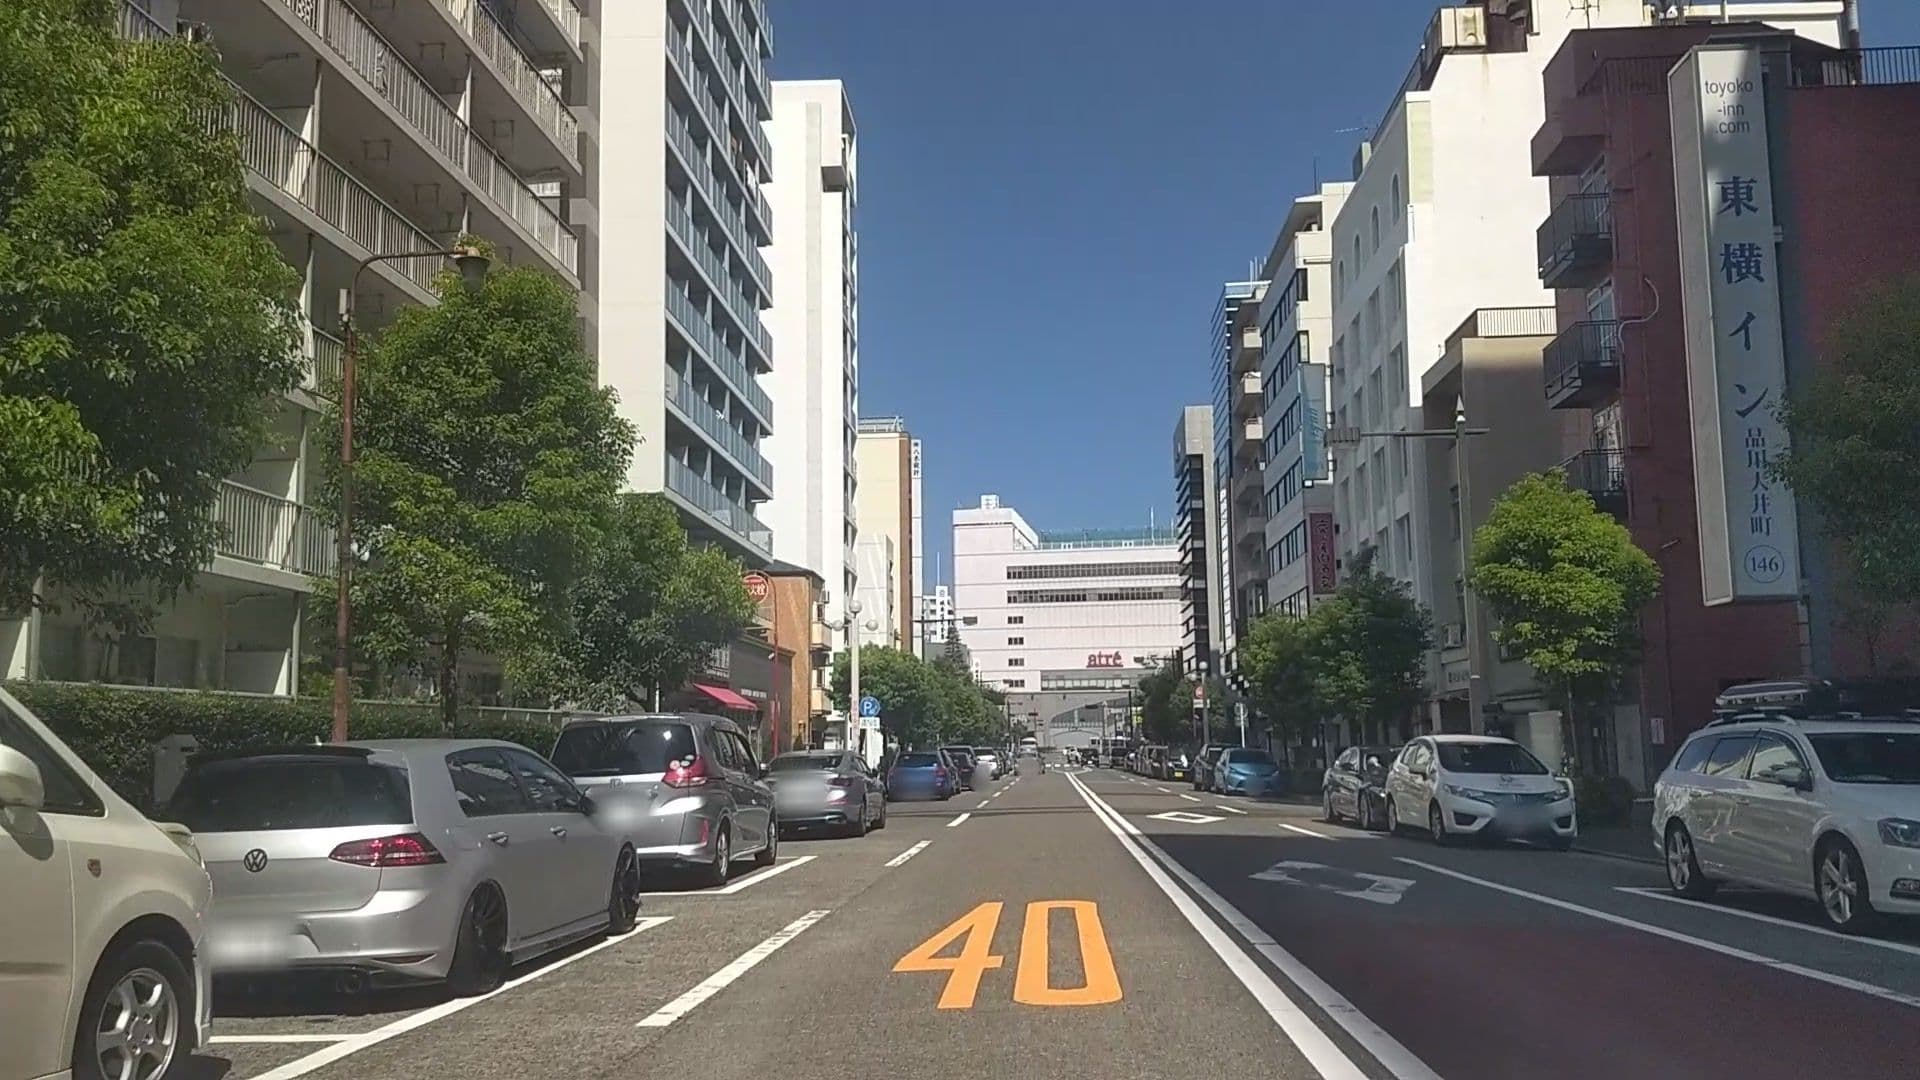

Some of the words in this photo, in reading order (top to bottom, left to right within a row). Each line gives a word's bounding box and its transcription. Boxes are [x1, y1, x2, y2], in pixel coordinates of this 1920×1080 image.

[1704, 78, 1754, 97] toyoko
[1717, 101, 1745, 116] -inn
[1715, 121, 1750, 134] .com
[1716, 175, 1769, 420] 東横イン
[1744, 427, 1773, 537] 品川大井町
[1750, 555, 1779, 572] 146
[1087, 650, 1123, 667] atré
[892, 900, 1124, 1009] 40
